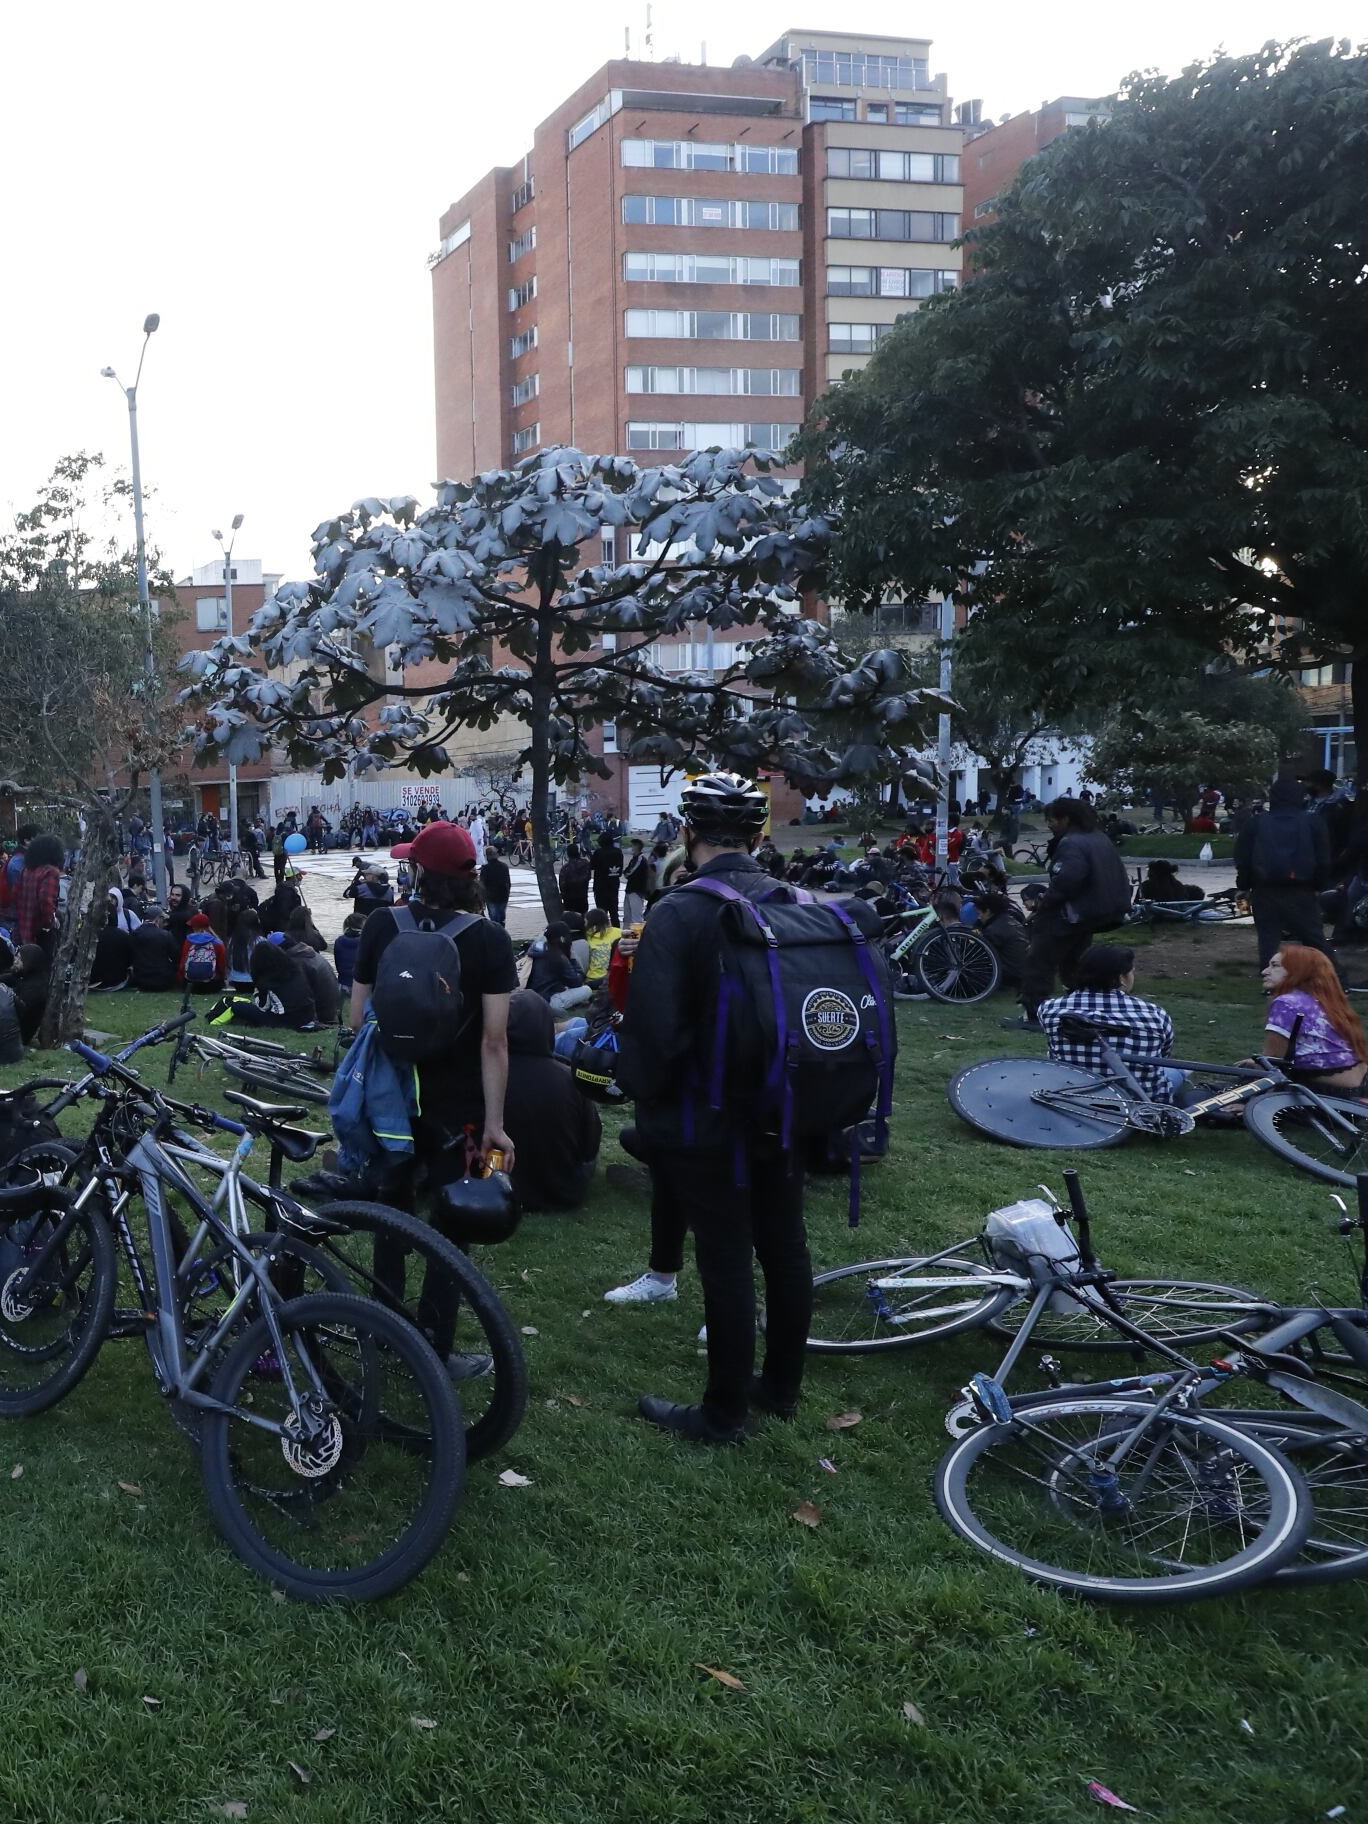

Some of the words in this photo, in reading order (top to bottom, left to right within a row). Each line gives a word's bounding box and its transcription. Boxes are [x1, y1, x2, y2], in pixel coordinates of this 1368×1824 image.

[402, 787, 412, 795] SE
[414, 786, 440, 795] VENDE
[817, 1011, 845, 1024] SUERTE
